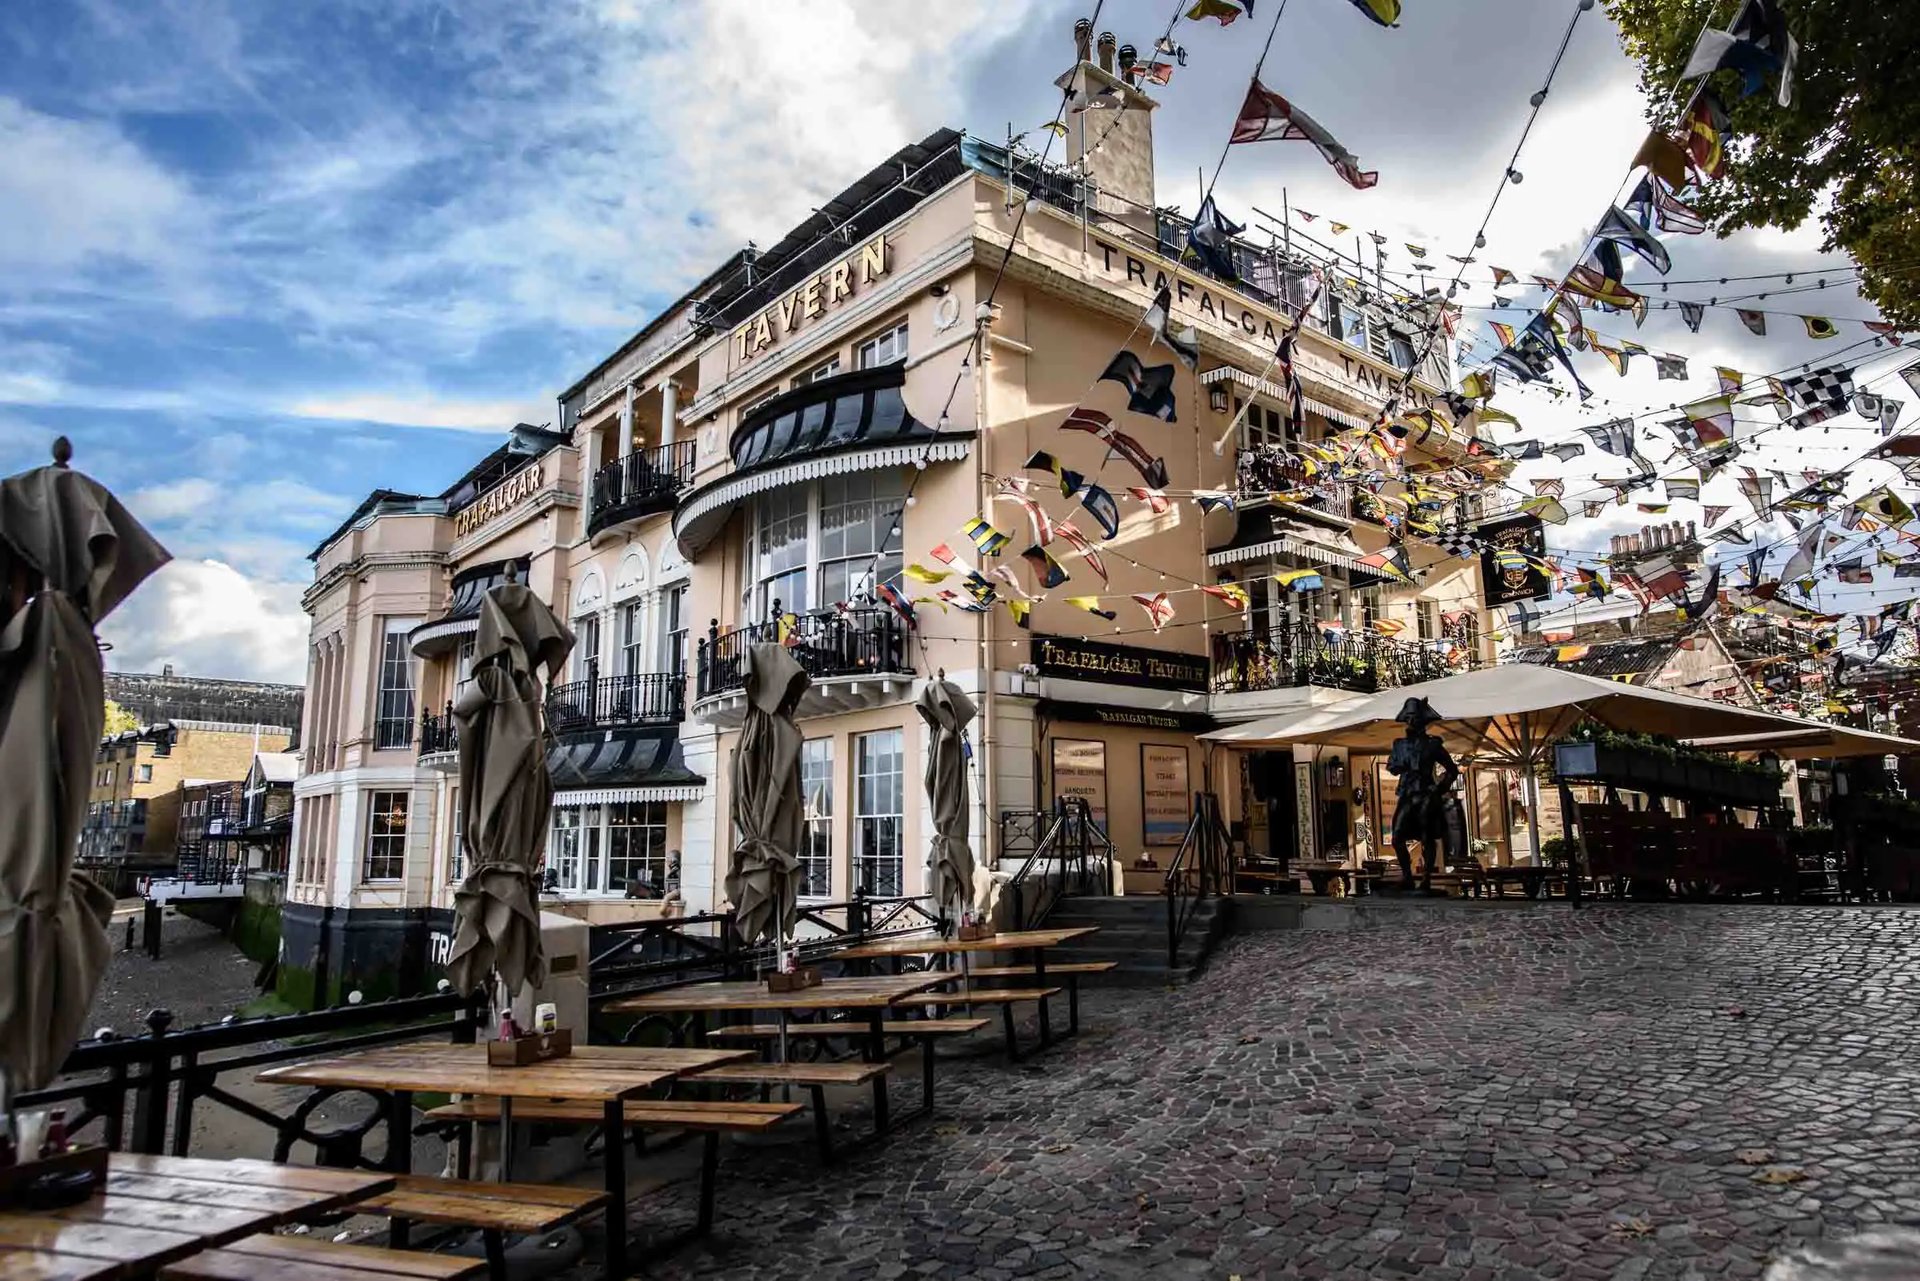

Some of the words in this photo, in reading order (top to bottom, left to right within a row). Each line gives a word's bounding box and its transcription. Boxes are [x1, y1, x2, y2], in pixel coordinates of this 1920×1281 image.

[736, 235, 886, 359] TAVERN
[1340, 354, 1433, 409] TAVERN
[455, 464, 541, 538] TRAFALGAR
[1042, 644, 1143, 675] TRAFALGAR
[1146, 658, 1204, 682] TAVERN
[1297, 766, 1313, 858] TRAFALGA
